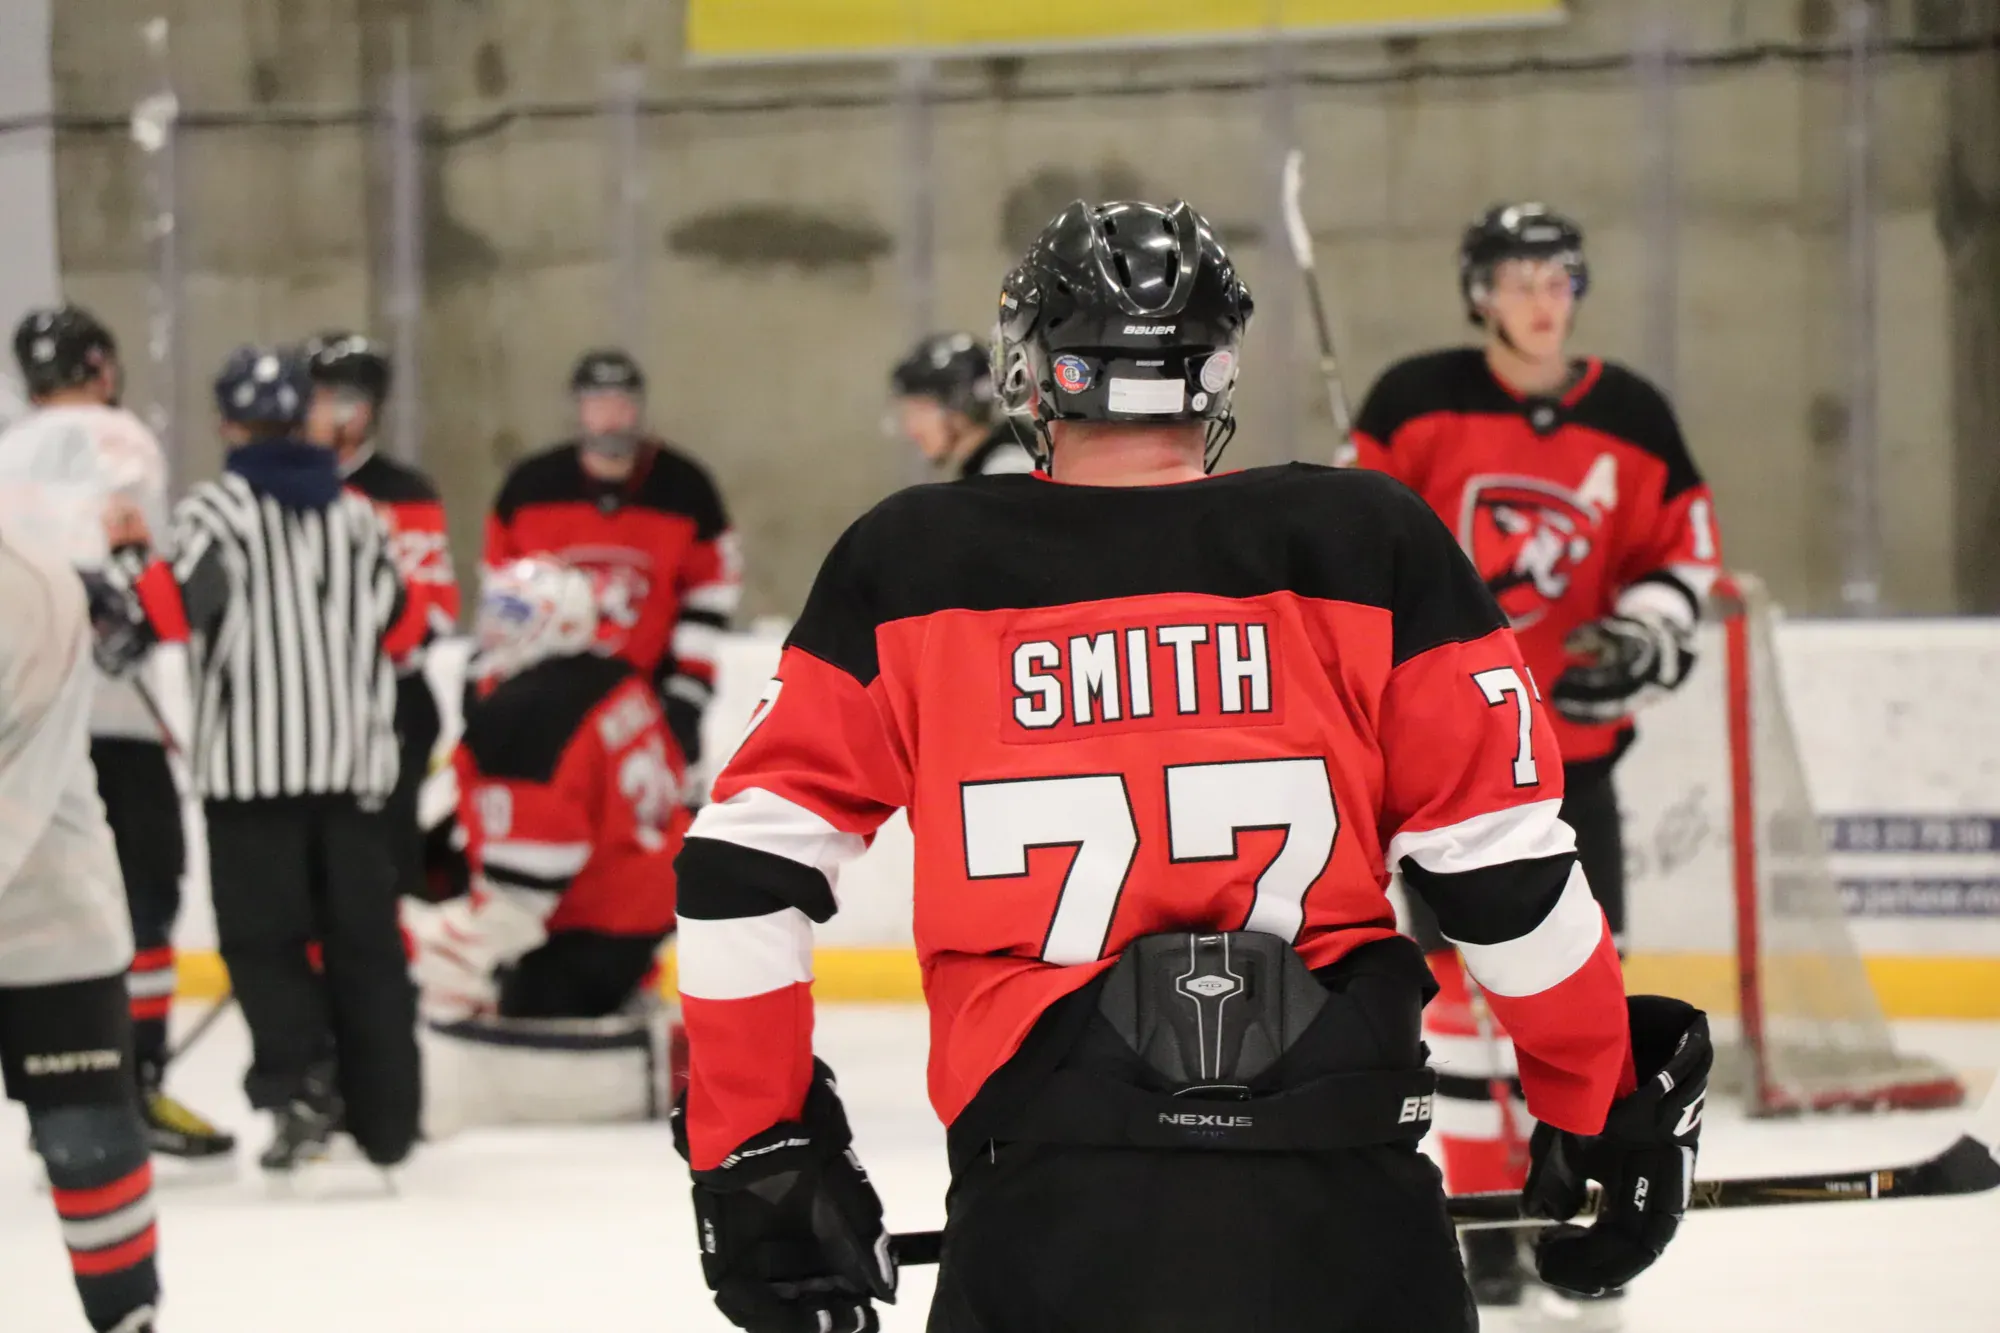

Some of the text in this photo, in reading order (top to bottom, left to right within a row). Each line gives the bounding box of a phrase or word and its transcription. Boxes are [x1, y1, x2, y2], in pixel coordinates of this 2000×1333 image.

[1012, 622, 1272, 730] SMITH
[960, 756, 1341, 964] 77
[1158, 1112, 1254, 1127] NEXUS
